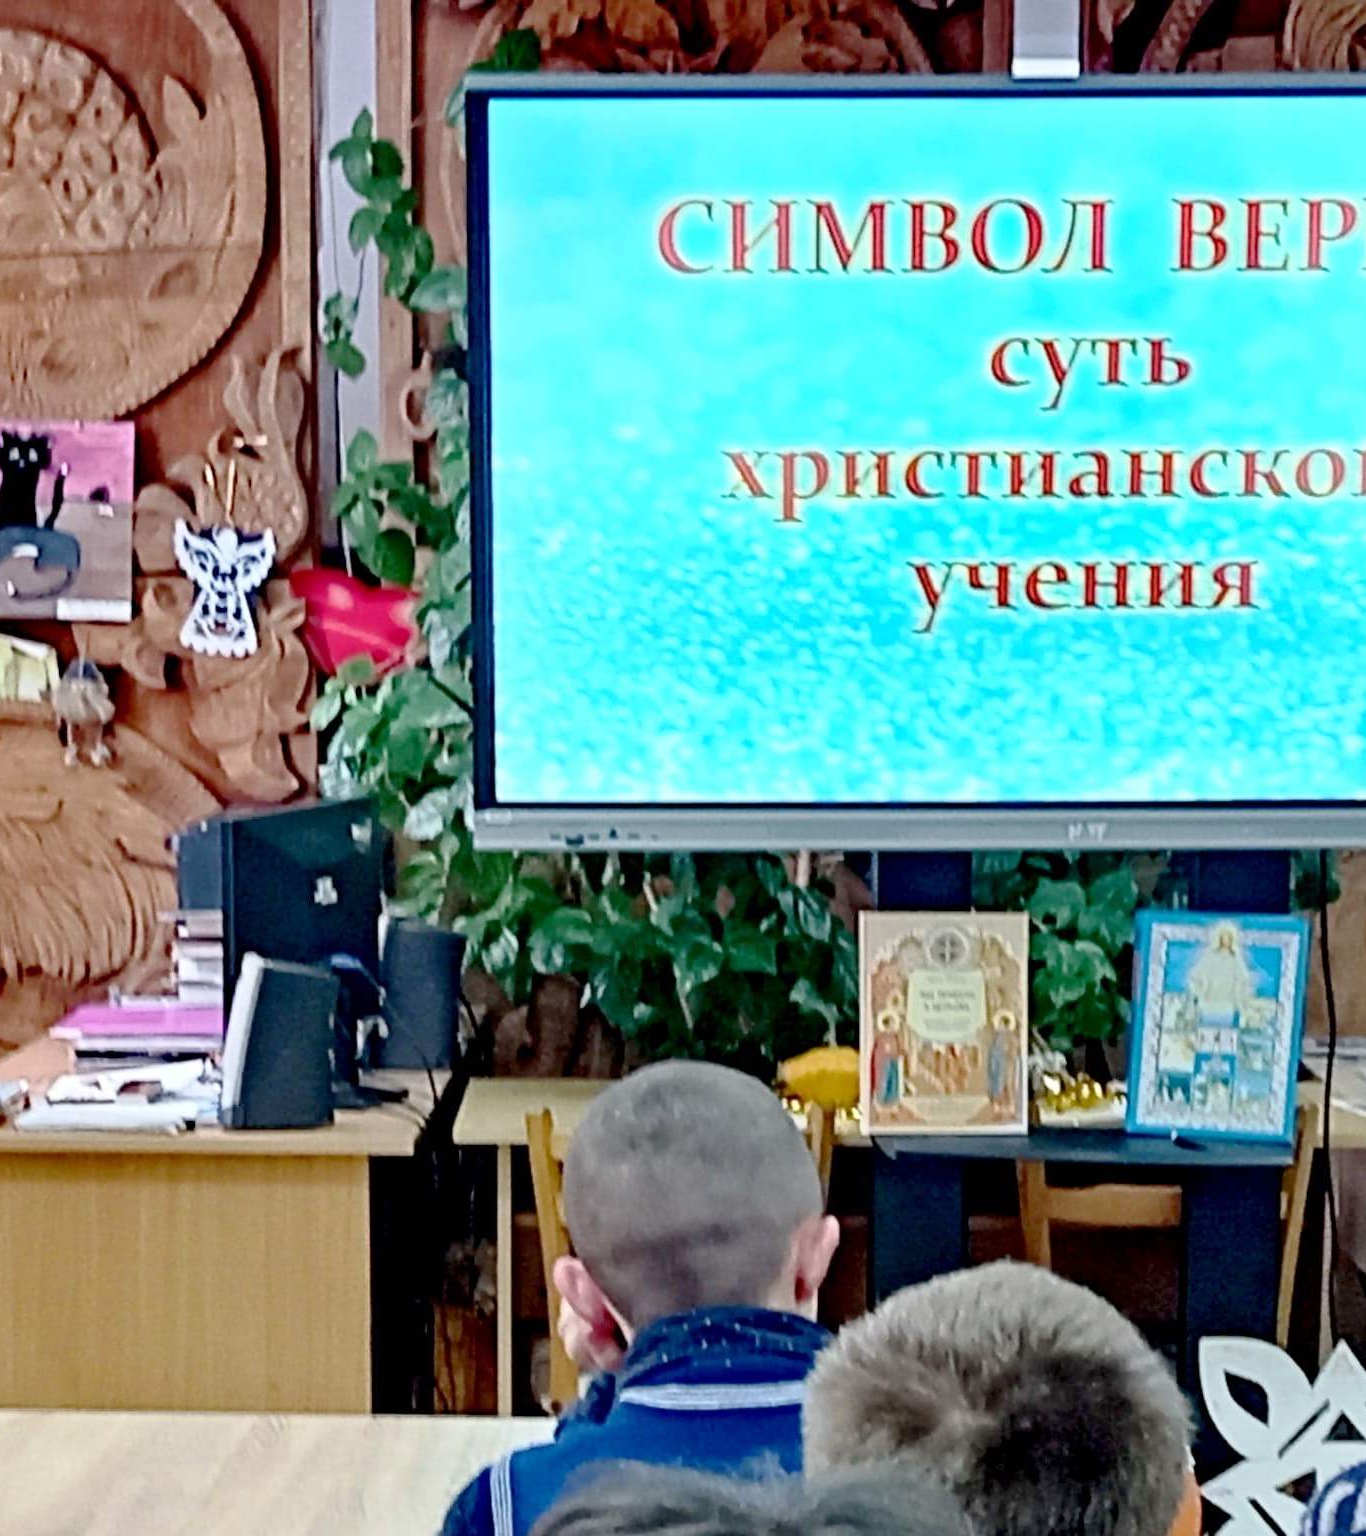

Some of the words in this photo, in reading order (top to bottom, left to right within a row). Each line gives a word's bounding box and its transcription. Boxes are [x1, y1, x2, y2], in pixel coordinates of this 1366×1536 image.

[656, 197, 1114, 275] СИМВОЛ
[989, 335, 1192, 411] суть
[911, 558, 1259, 634] учения
